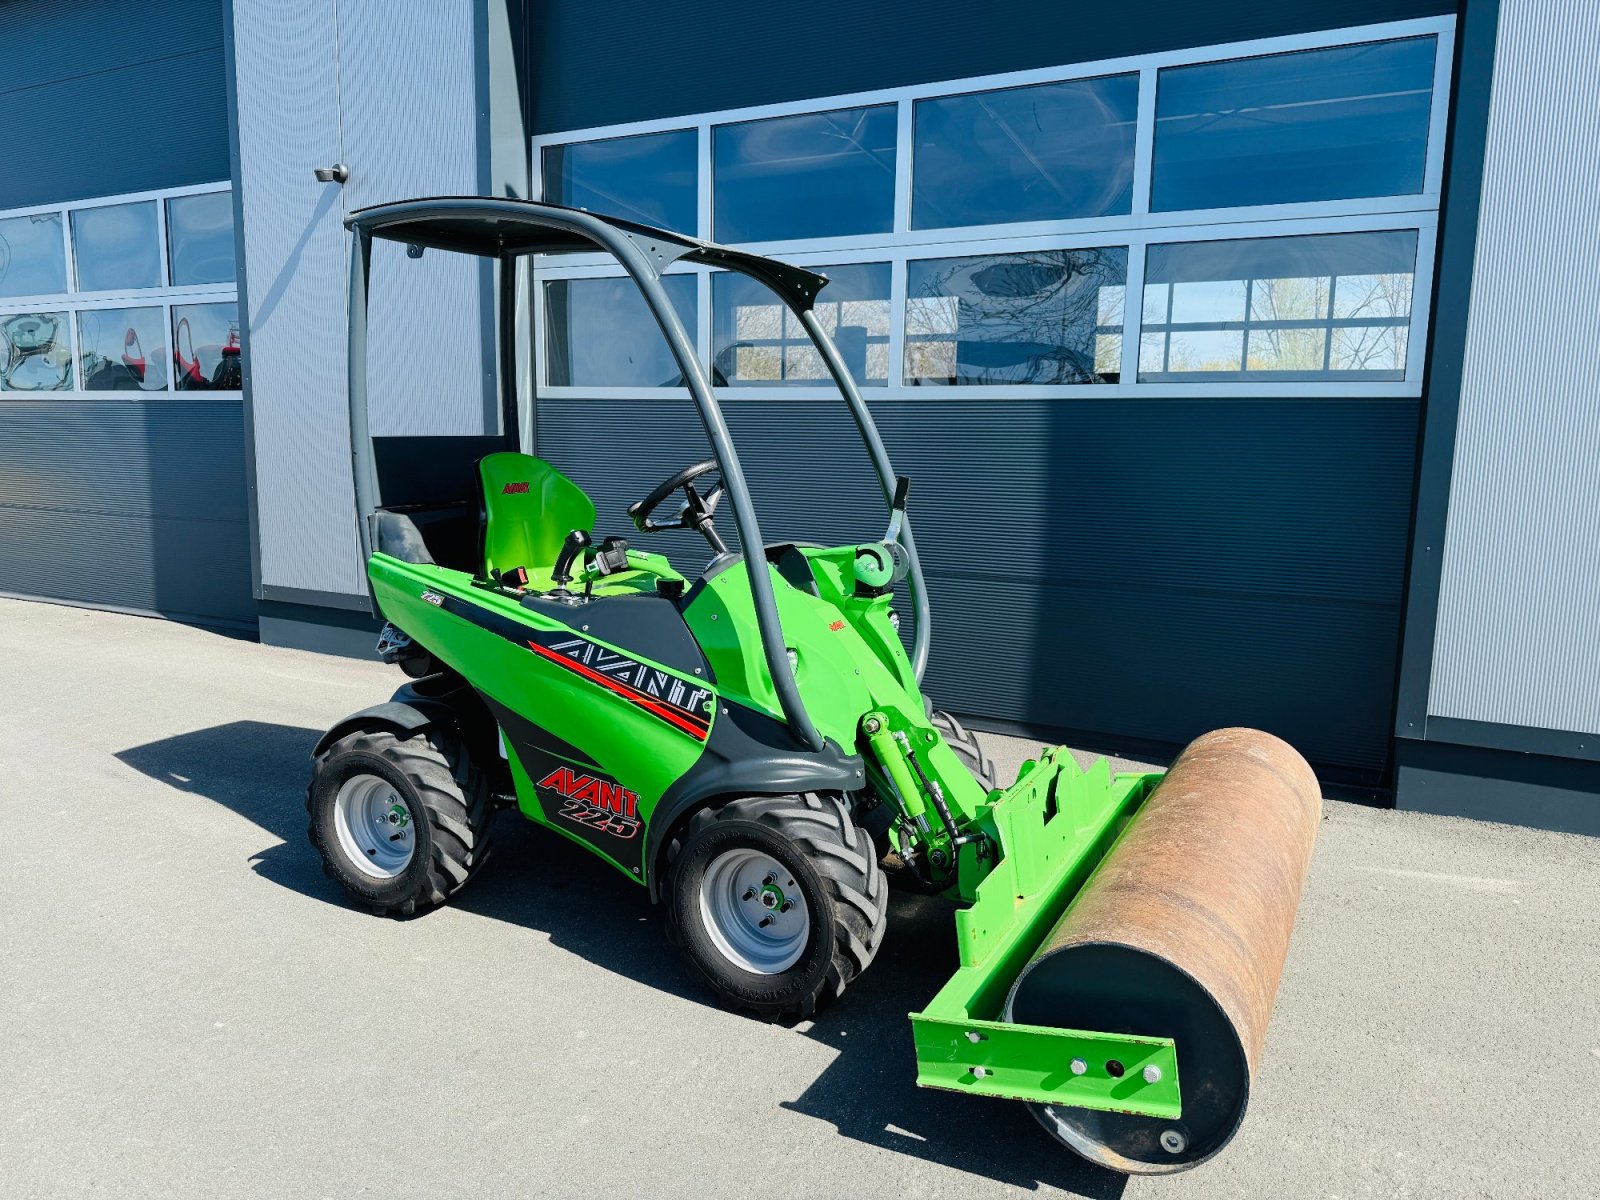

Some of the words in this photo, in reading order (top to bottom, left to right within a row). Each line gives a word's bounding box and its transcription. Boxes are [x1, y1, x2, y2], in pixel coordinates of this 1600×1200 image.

[548, 639, 712, 712] AVANT
[536, 766, 638, 819] AVANT
[558, 799, 641, 839] 225
